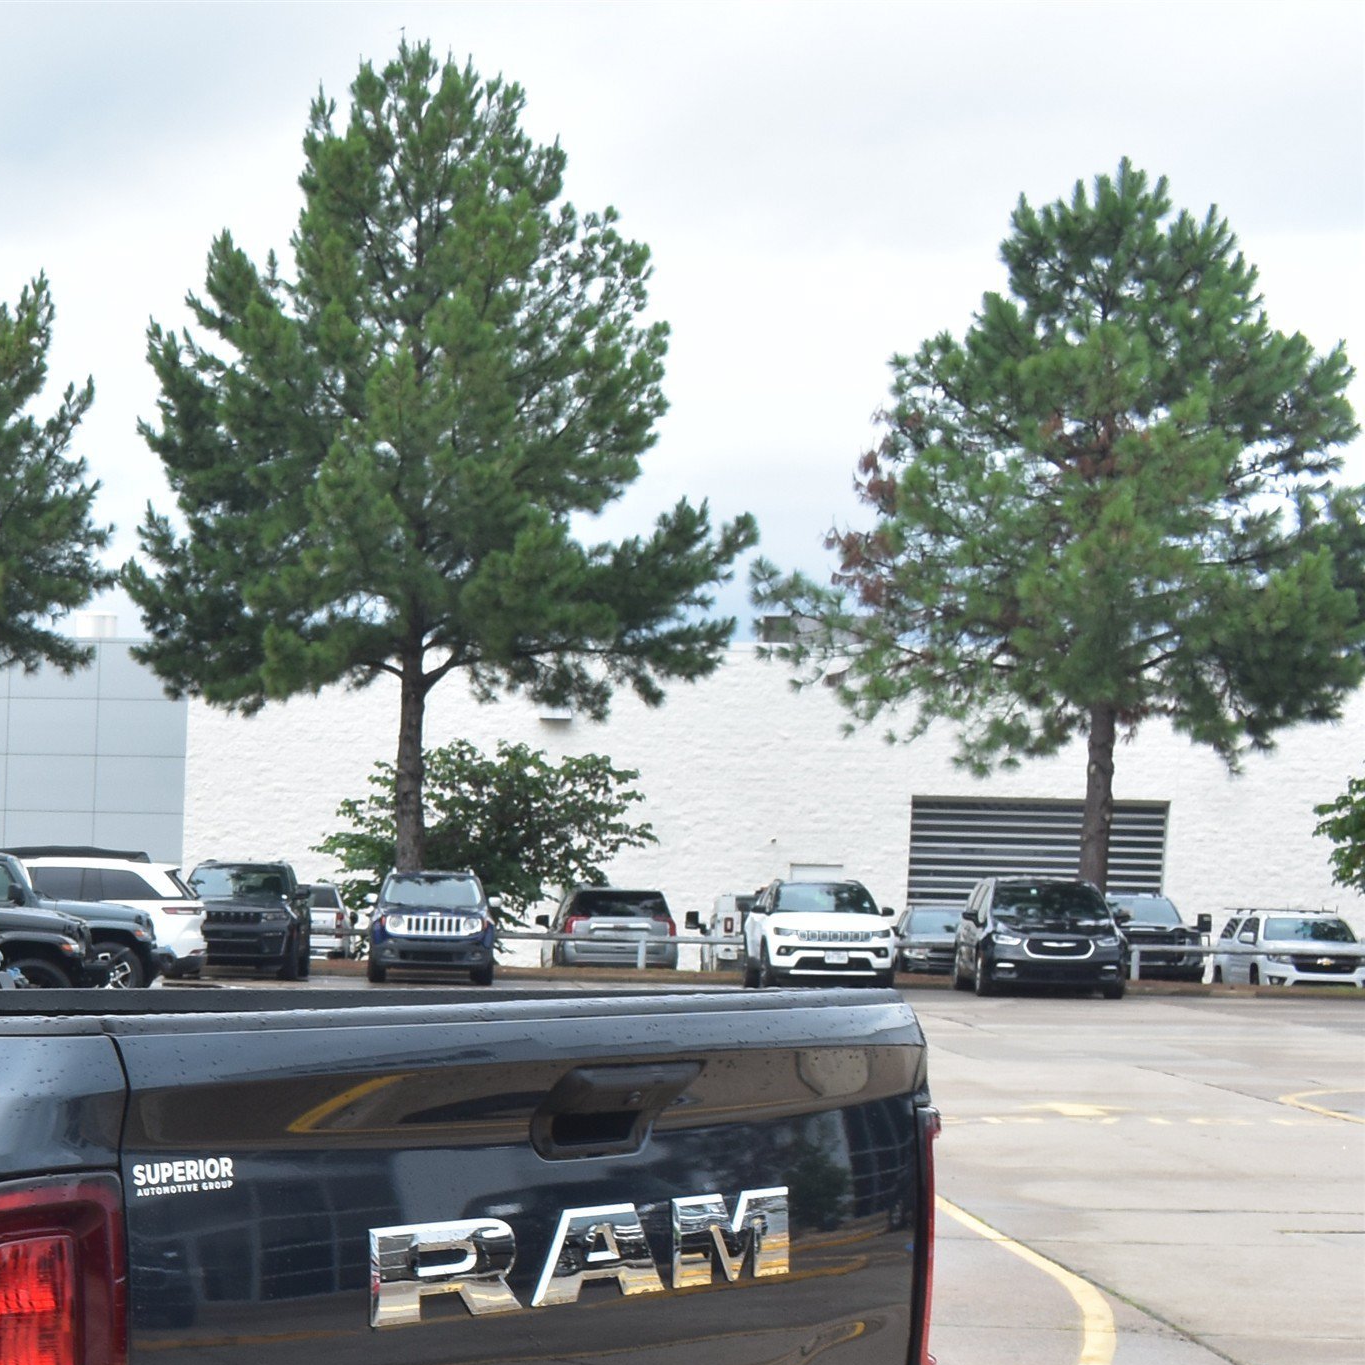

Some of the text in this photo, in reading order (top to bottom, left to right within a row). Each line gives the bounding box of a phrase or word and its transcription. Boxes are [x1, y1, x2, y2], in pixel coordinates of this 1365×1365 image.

[132, 1157, 234, 1186] SUPERIOR
[136, 1180, 234, 1197] AUTOMOTIVE GROUP
[369, 1186, 789, 1328] RAM
